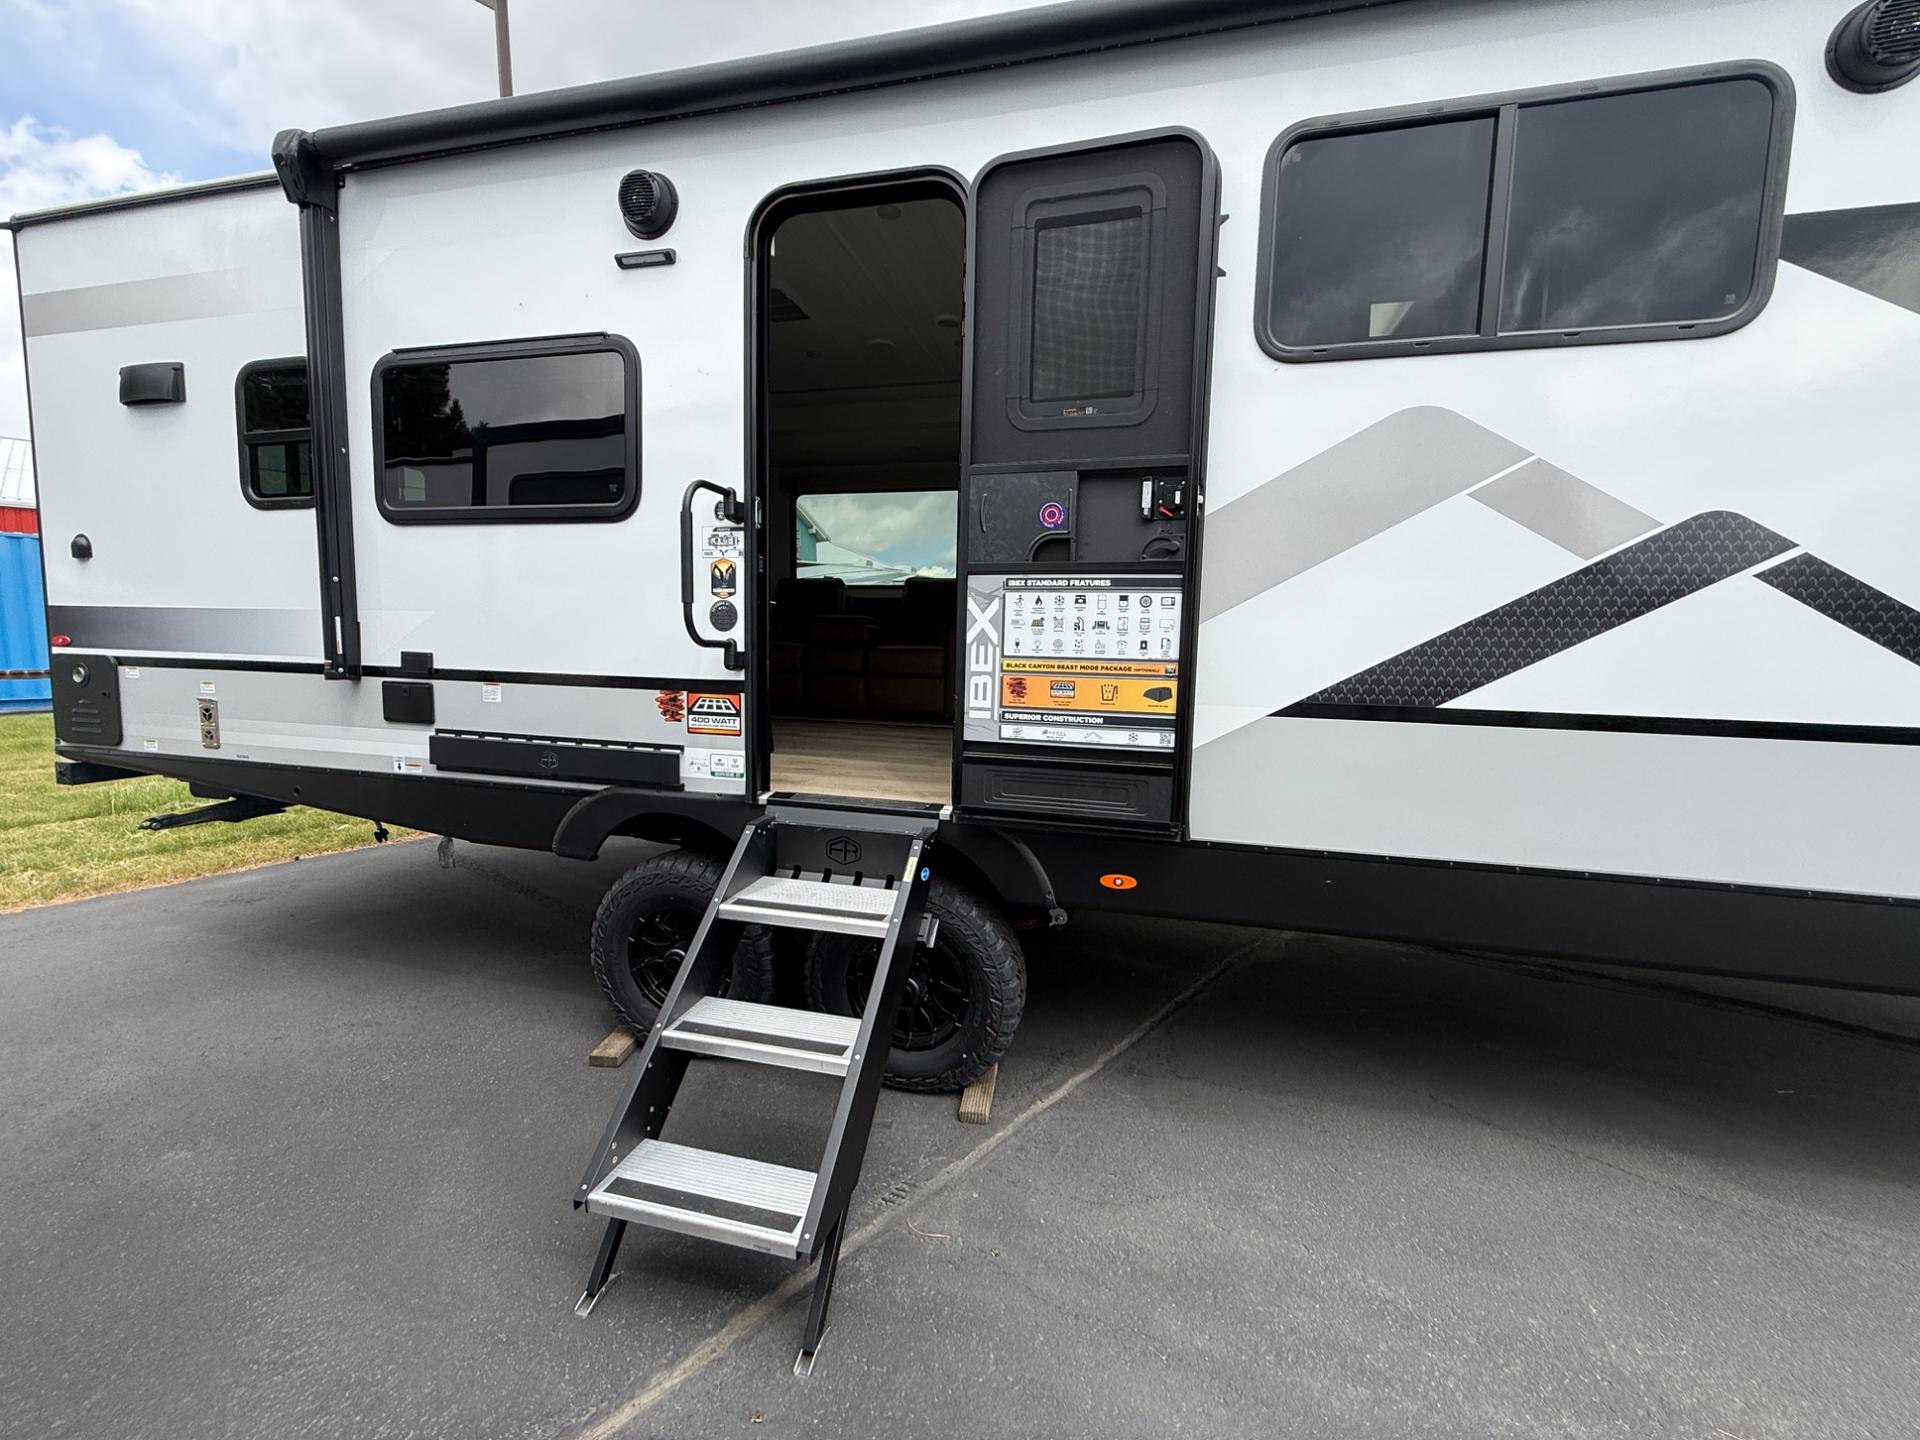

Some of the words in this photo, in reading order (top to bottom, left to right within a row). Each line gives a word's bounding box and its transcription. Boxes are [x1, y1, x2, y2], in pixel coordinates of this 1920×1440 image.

[1008, 579, 1025, 587] IBEX
[1027, 579, 1068, 587] STANDARD
[1070, 579, 1111, 587] FEATURES
[966, 596, 999, 719] IBEX
[711, 717, 738, 725] WATT
[1004, 712, 1041, 721] SUPERIOR
[1043, 714, 1103, 724] CONSTRUCTION
